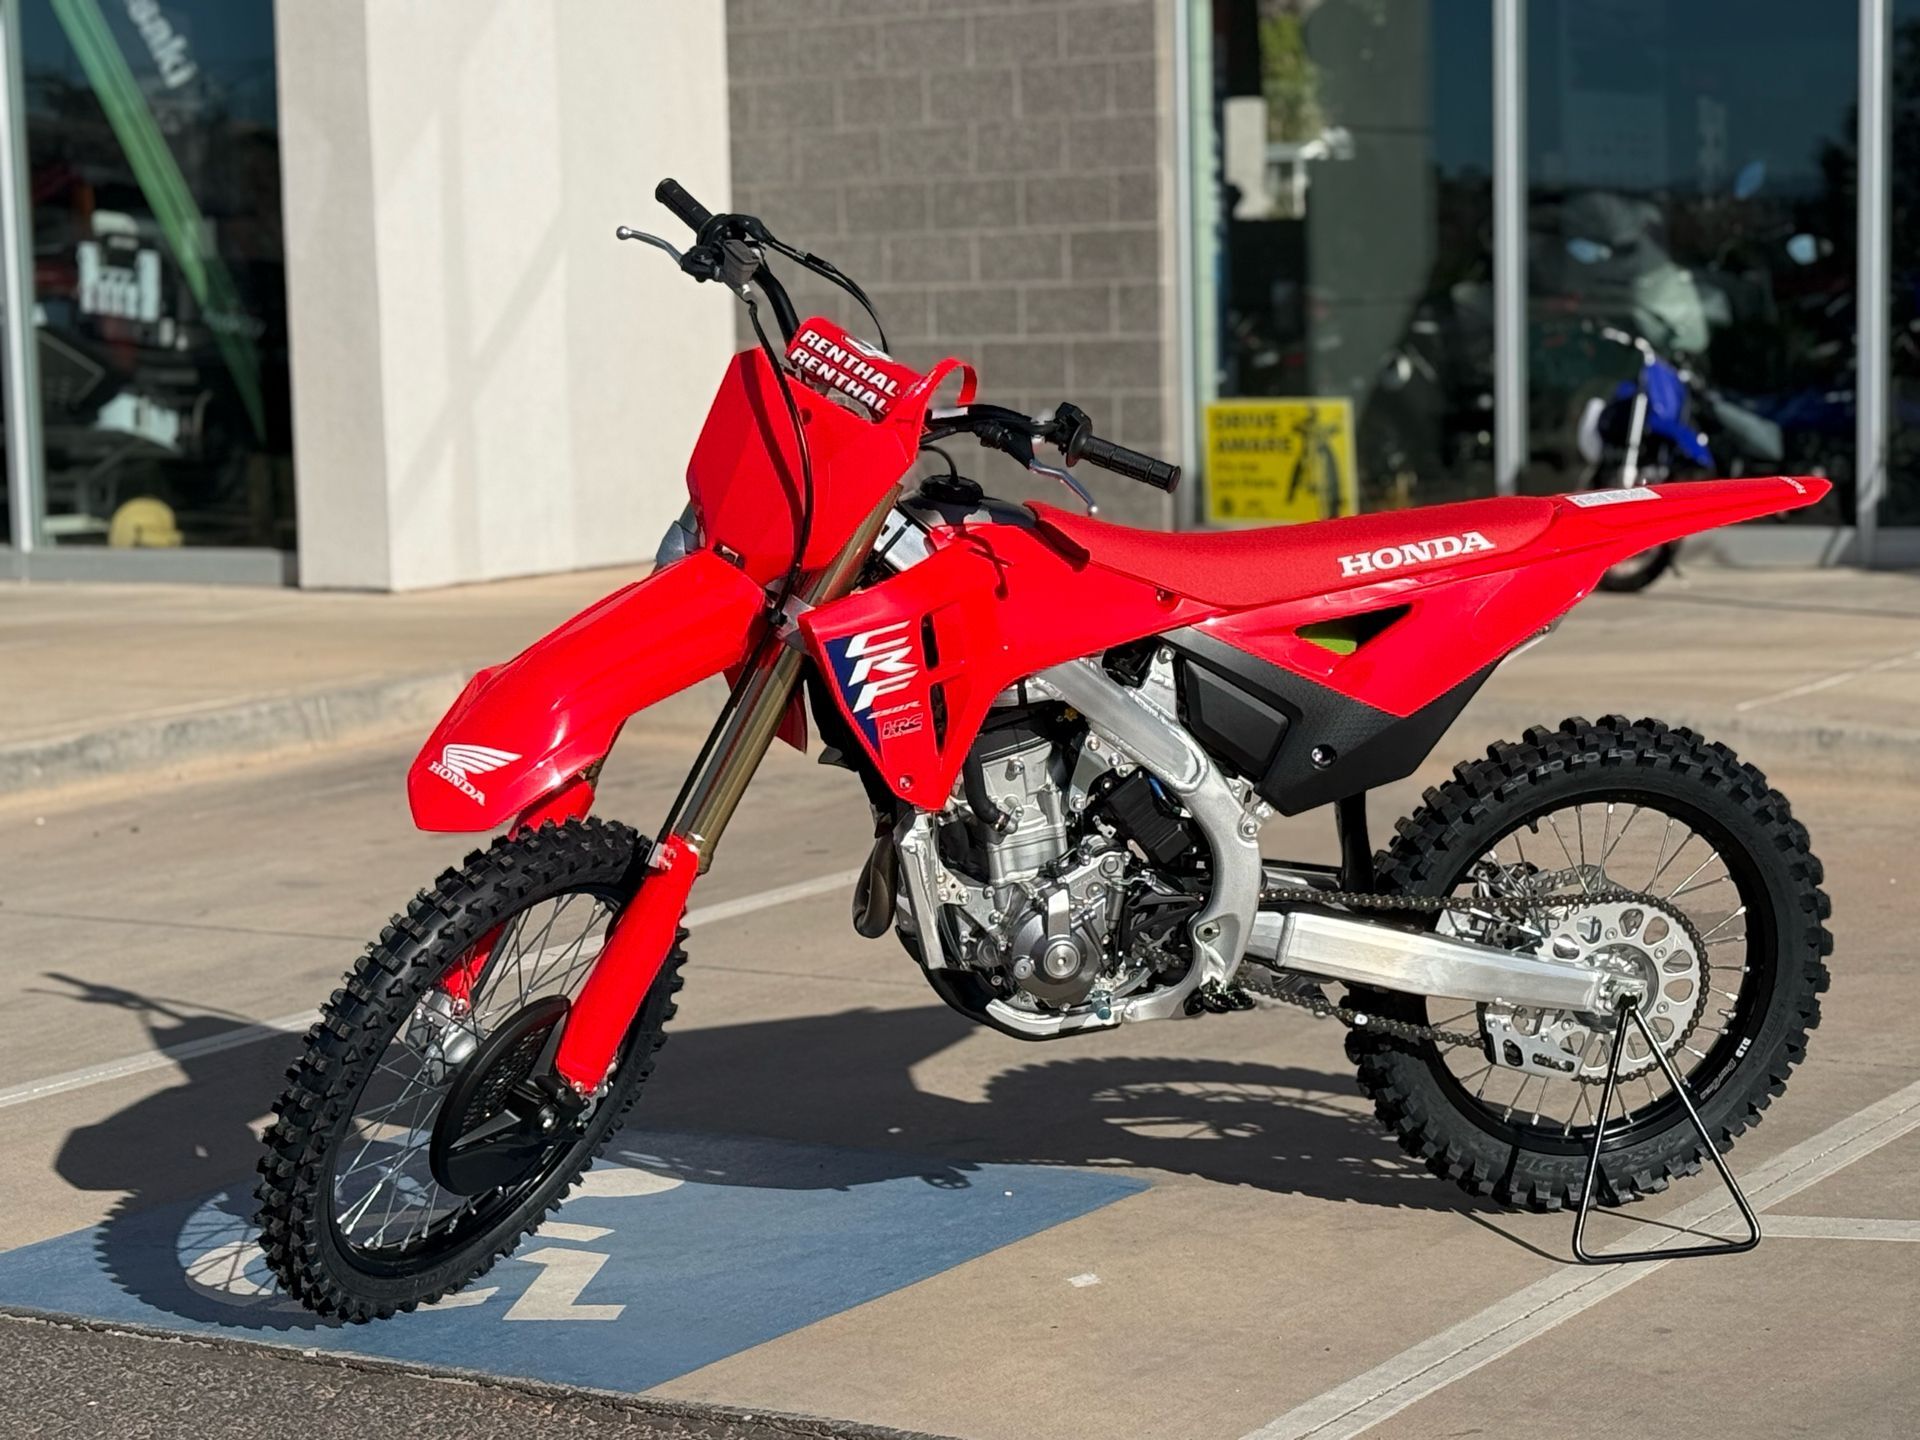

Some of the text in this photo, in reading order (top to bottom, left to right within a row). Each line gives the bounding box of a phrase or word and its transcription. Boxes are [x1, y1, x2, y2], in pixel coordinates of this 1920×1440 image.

[790, 347, 888, 415] RENTHAL
[799, 329, 898, 398] RENTHAL
[1337, 530, 1496, 577] HONDA
[845, 620, 920, 714] CRF
[882, 712, 924, 740] HRC
[427, 761, 487, 807] HONDA
